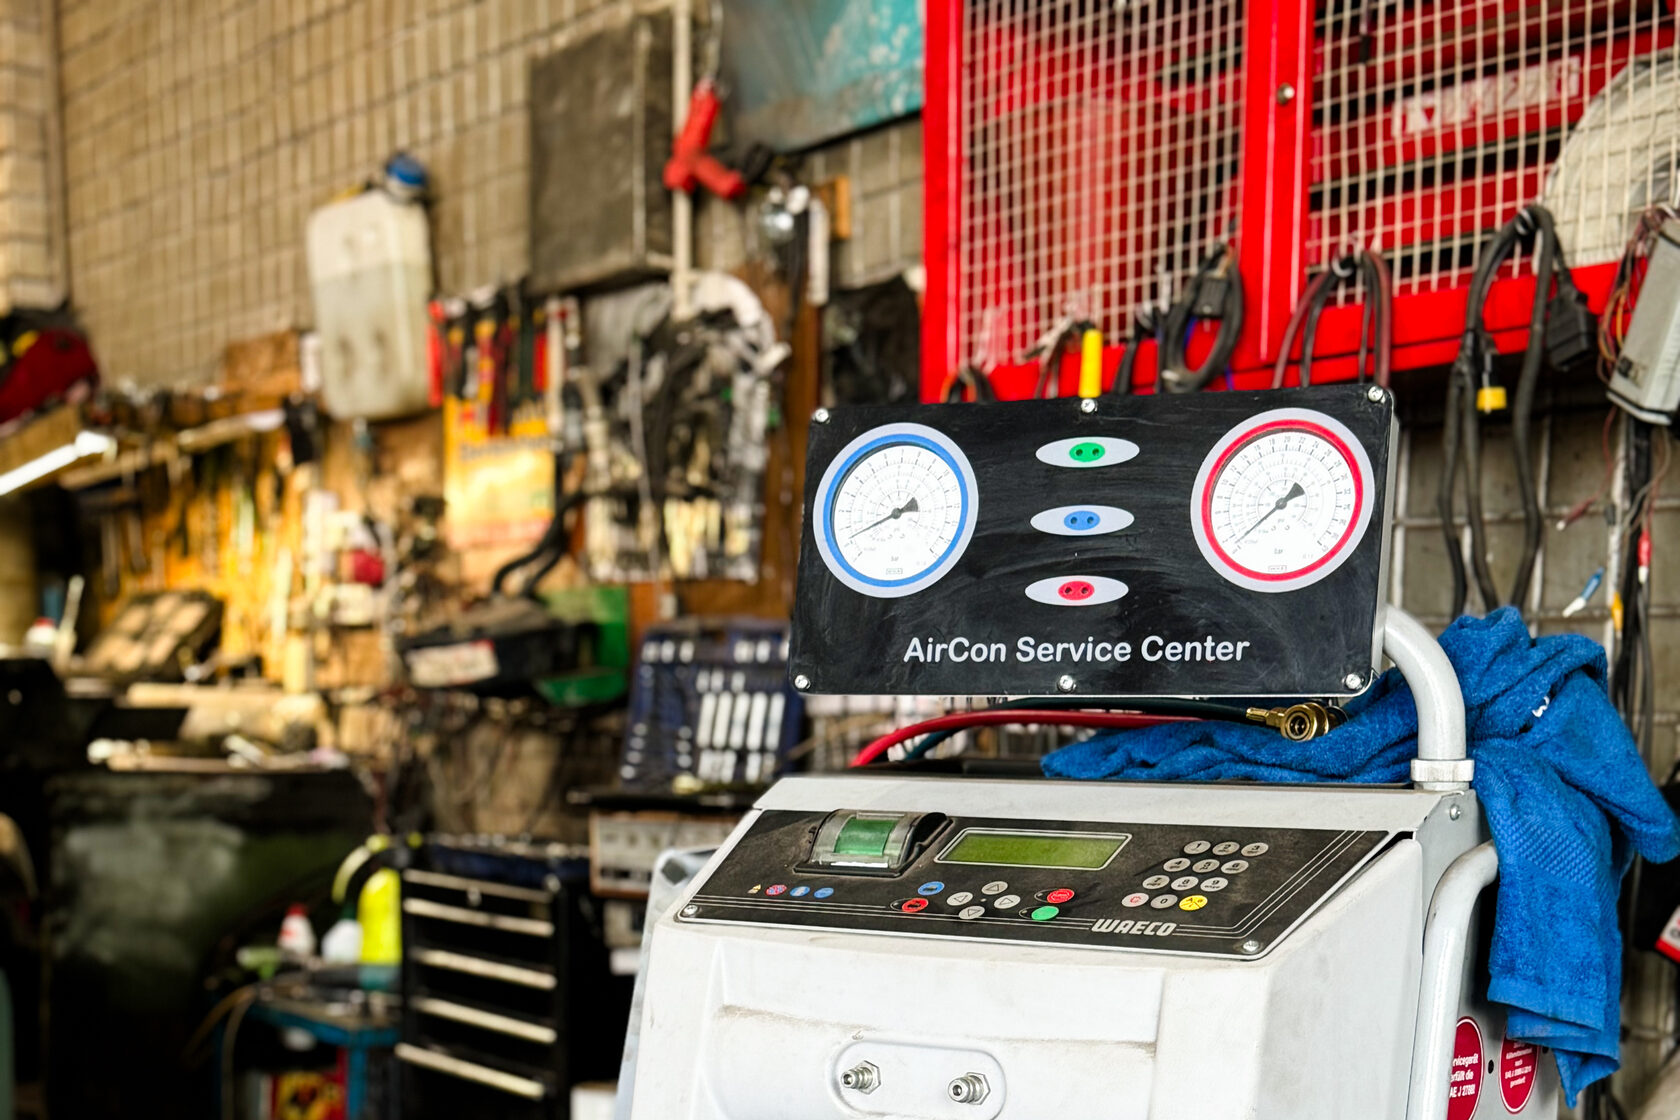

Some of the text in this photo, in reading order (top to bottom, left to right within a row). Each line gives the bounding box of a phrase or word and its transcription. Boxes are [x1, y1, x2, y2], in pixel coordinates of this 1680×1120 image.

[903, 635, 1251, 663] AirCon Service Center
[1091, 918, 1177, 937] WAECO
